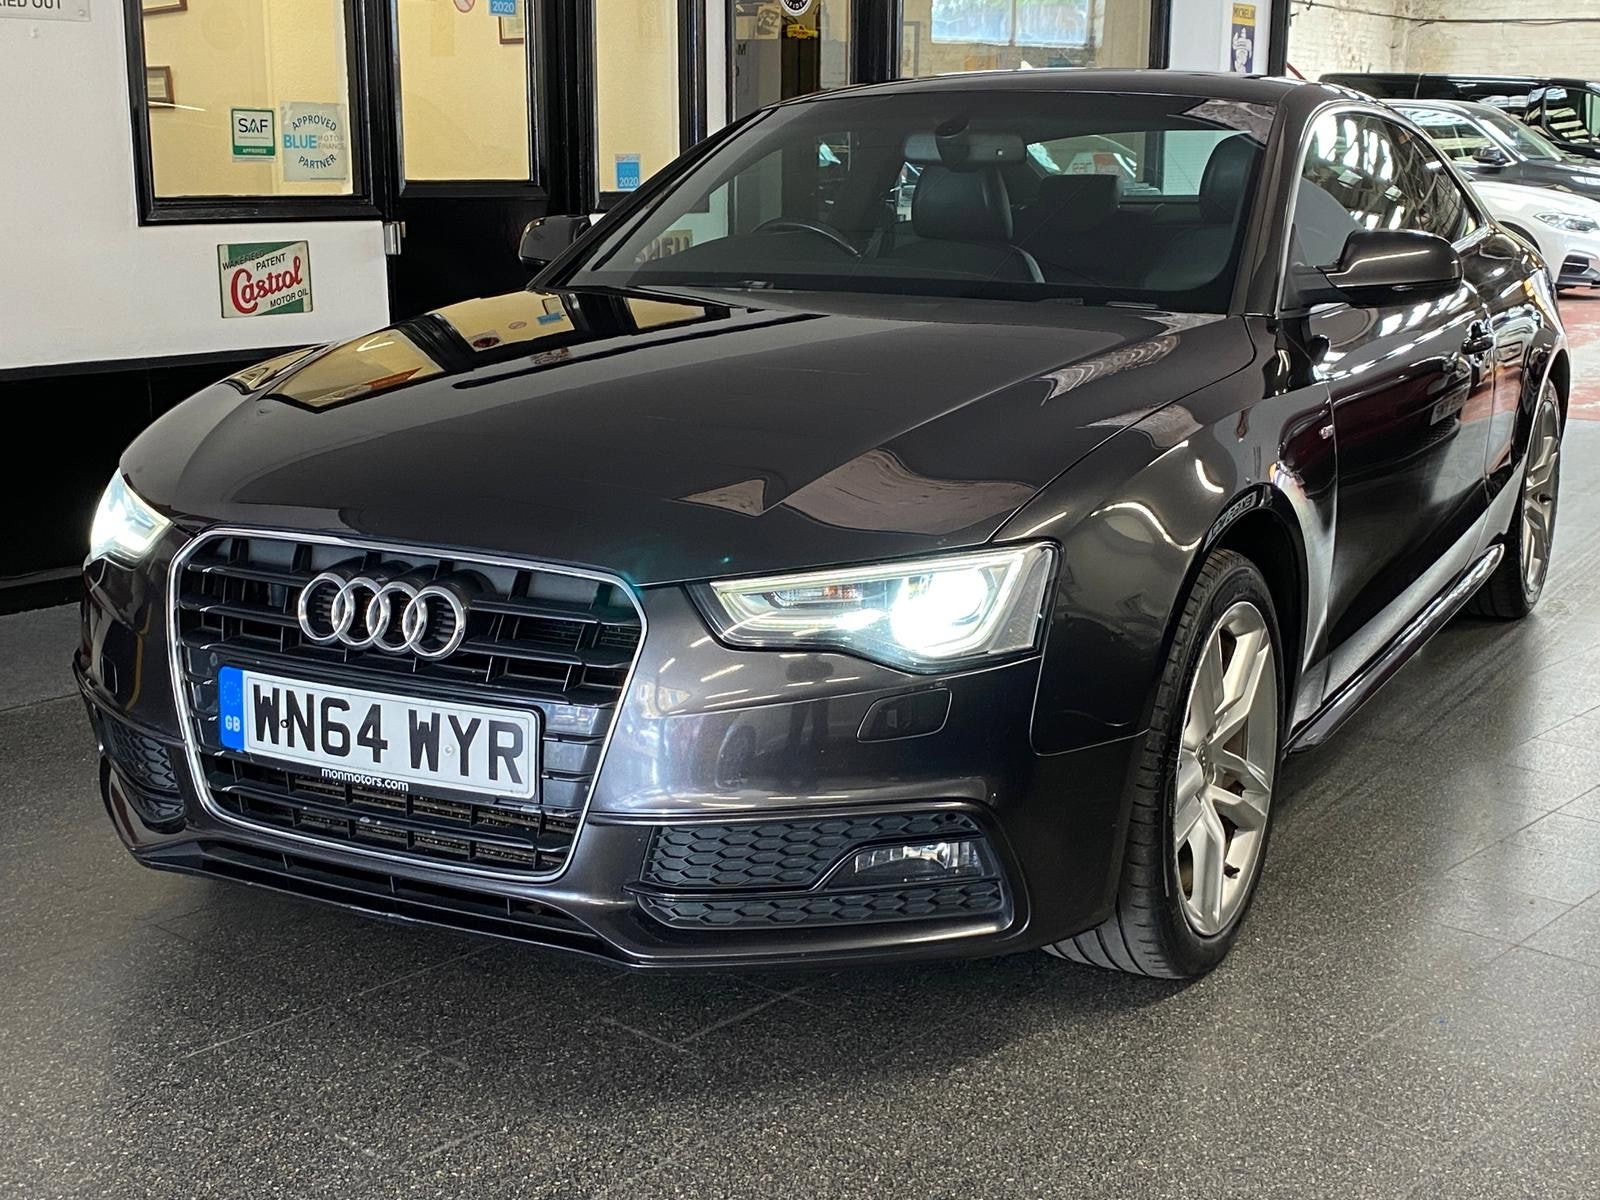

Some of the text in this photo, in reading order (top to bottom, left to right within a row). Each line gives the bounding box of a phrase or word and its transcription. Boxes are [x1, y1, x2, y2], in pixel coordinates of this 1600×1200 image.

[492, 1, 515, 13] 2020
[238, 118, 269, 133] SAF
[292, 115, 337, 132] APPROVED
[283, 134, 318, 149] BLUE
[298, 154, 337, 169] PARTNER
[620, 176, 639, 187] 2020
[222, 250, 266, 271] WAKEFIELD
[256, 253, 286, 271] PATENT
[231, 256, 303, 314] Castrol
[269, 288, 309, 308] MOTOR OIL
[224, 714, 241, 732] GB
[252, 683, 524, 785] WN64 WYR
[320, 767, 409, 792] monmotors.com
